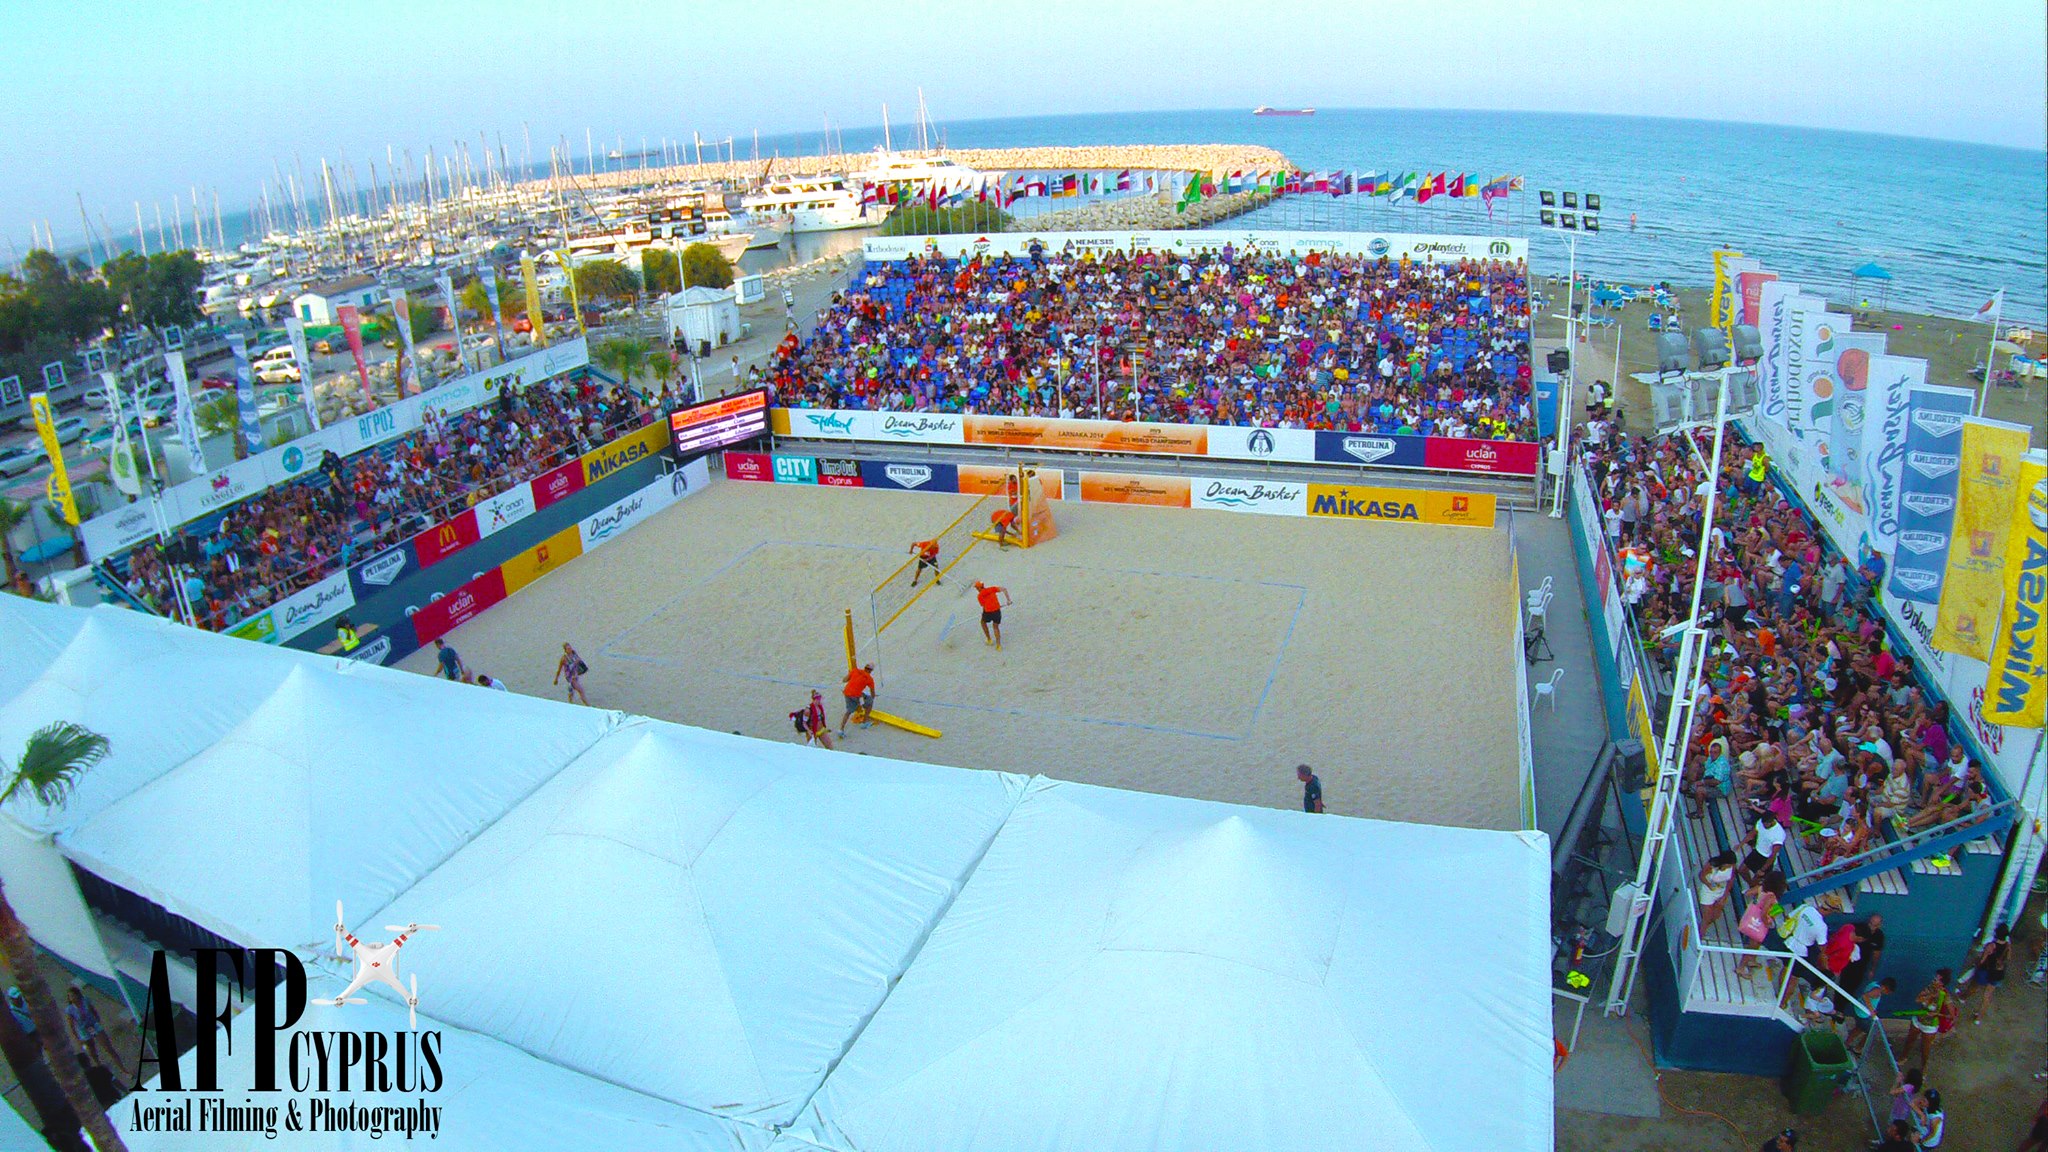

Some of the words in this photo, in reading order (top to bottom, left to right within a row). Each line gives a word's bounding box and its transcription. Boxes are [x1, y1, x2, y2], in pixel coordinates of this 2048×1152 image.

[884, 416, 918, 430] Ocean
[916, 418, 956, 431] Basket
[1347, 440, 1391, 450] PETROLINA
[1466, 446, 1497, 460] uclan
[736, 461, 760, 471] uclan
[776, 458, 811, 477] CITY
[889, 467, 927, 477] PETROLINA
[827, 476, 853, 486] Cyprus
[1206, 481, 1249, 498] Ocean
[1246, 484, 1301, 501] Basket
[364, 551, 402, 578] PETROLINA
[448, 593, 475, 615] uclan
